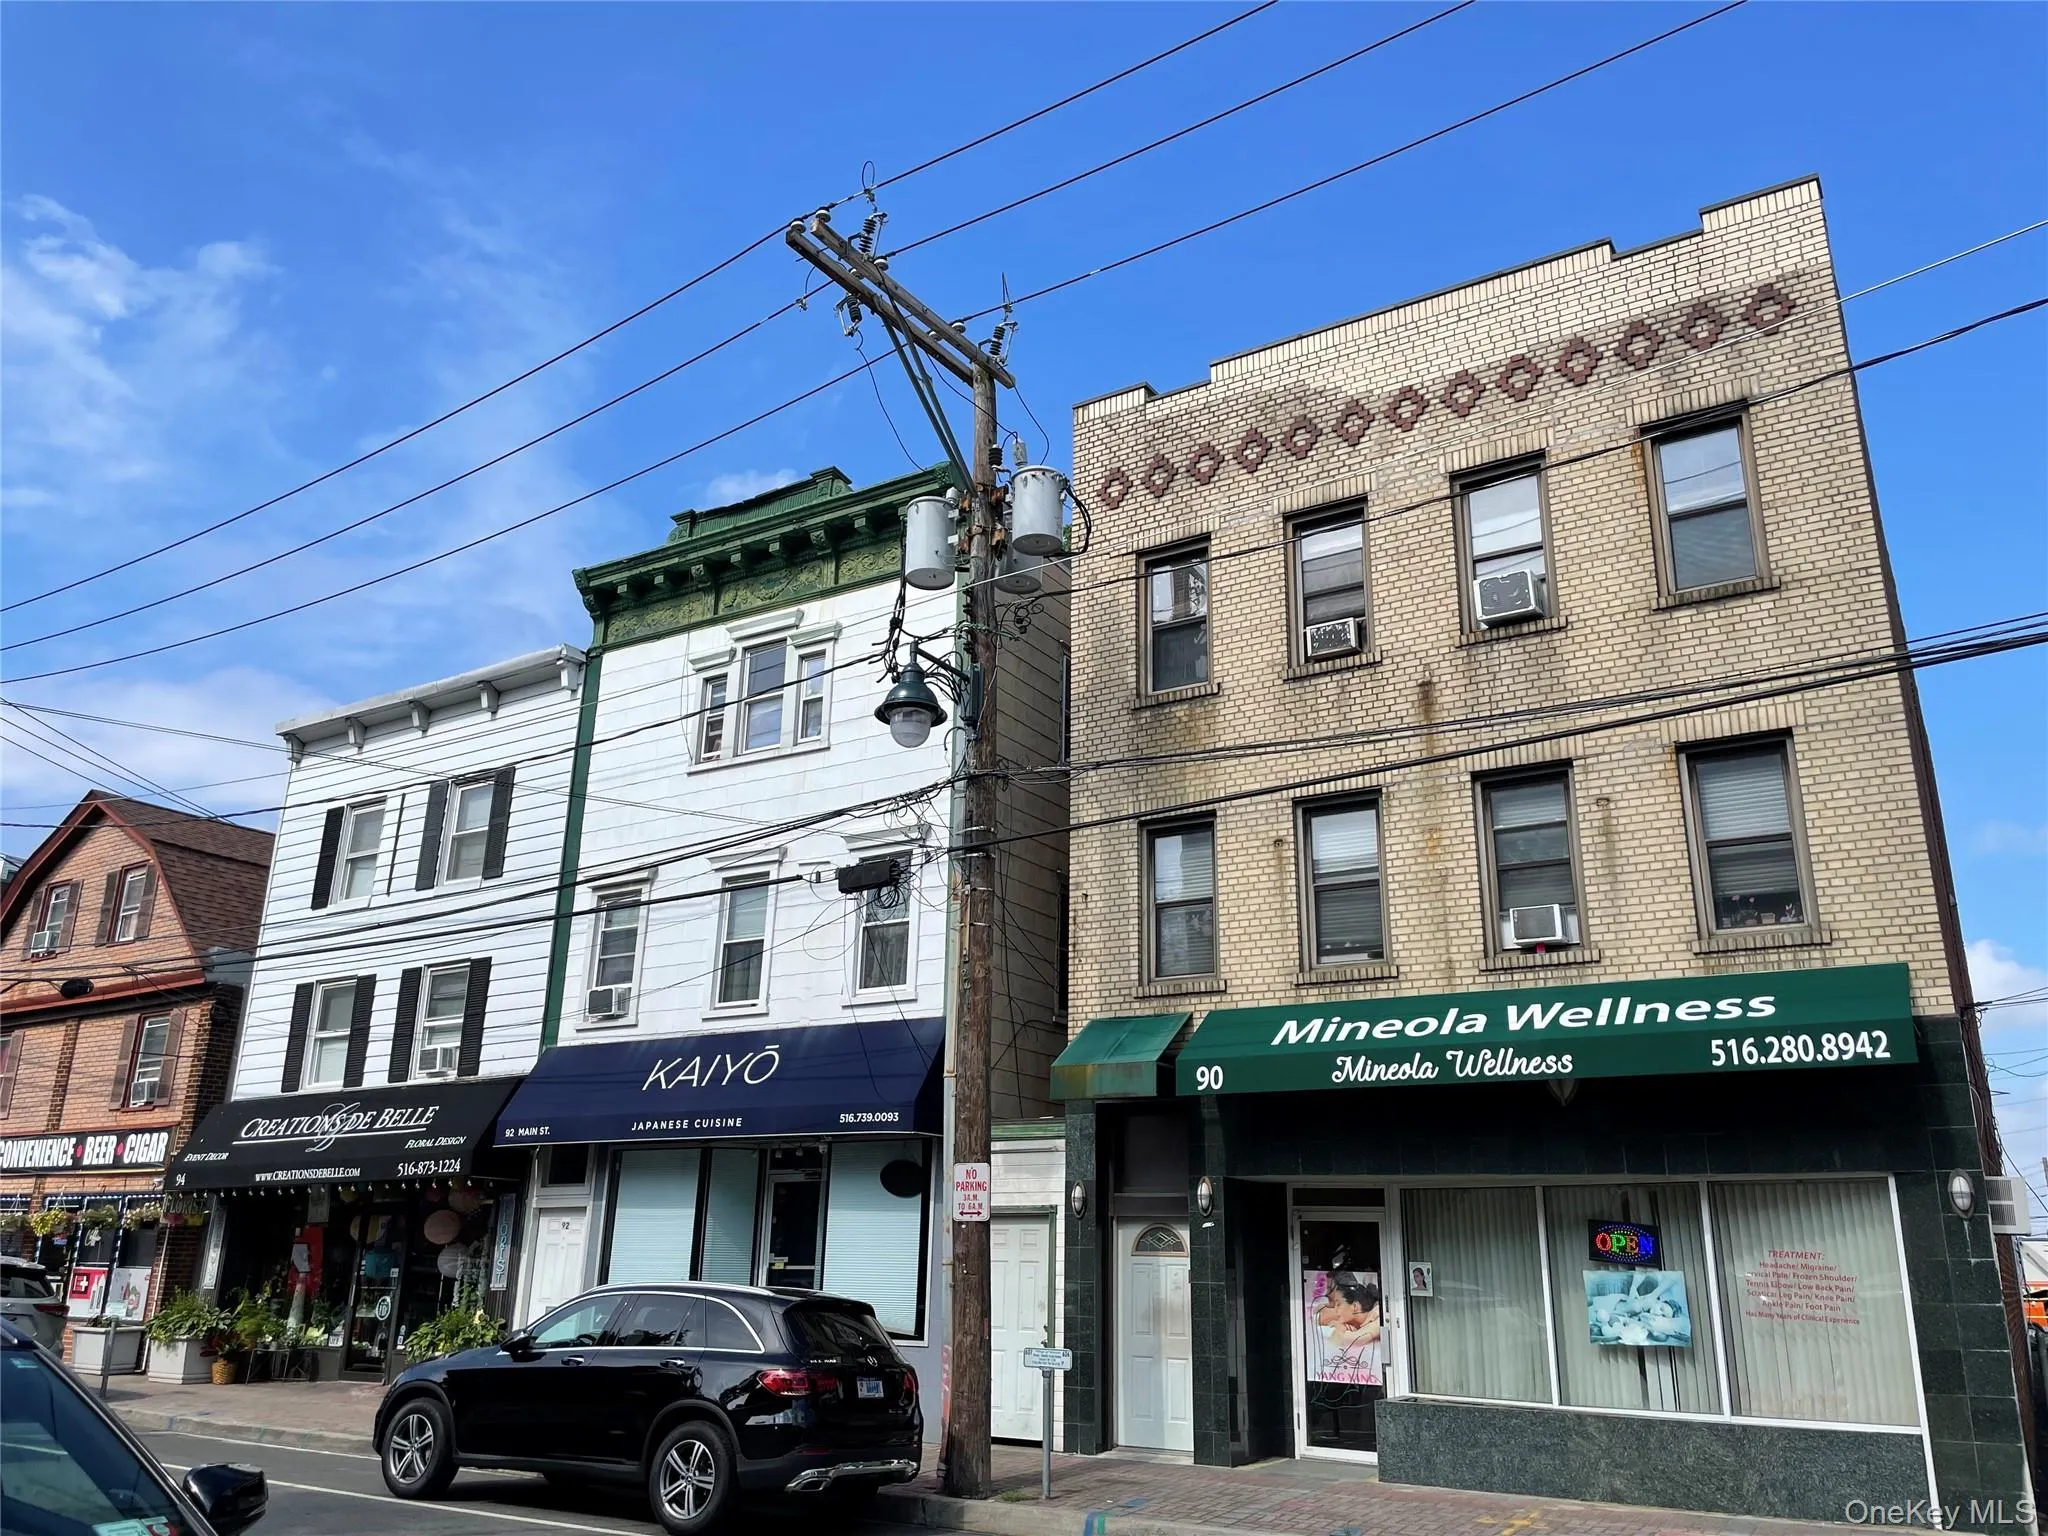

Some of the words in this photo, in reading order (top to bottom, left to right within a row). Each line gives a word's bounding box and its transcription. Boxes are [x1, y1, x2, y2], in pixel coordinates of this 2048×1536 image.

[1271, 1008, 1488, 1046] Mineola
[1506, 995, 1776, 1032] Wellness
[1710, 1030, 1891, 1067] 516.280.8942
[641, 1044, 780, 1091] KAIYŌ
[1331, 1053, 1440, 1084] Mineola
[1446, 1047, 1574, 1078] Wellness
[1196, 1065, 1224, 1091] 90
[241, 1112, 346, 1138] CREATIONS
[344, 1111, 377, 1131] DE
[373, 1106, 440, 1129] BELLE
[631, 1120, 689, 1131] JAPANESE
[694, 1117, 743, 1129] CUISINE
[839, 1112, 899, 1124] 516.739.0093
[505, 1128, 515, 1137] 92
[518, 1127, 538, 1137] MAIN
[539, 1126, 551, 1136] ST.
[405, 1139, 434, 1149] FLORAL
[435, 1136, 467, 1147] DESIGN
[82, 1135, 117, 1166] BEER
[123, 1132, 169, 1164] CIGAR
[205, 1152, 229, 1161] DECOR
[397, 1158, 461, 1177] 516-873-1224
[175, 1173, 186, 1187] 94
[965, 1168, 978, 1180] NO
[955, 1181, 988, 1192] PARKING
[562, 1222, 570, 1230] 92
[1595, 1232, 1654, 1255] OPEN
[1767, 1249, 1825, 1261] TREATMENT:
[1759, 1261, 1799, 1269] Headache/
[1793, 1273, 1818, 1281] Frozen
[1798, 1282, 1814, 1290] Low
[1815, 1283, 1834, 1292] Back
[1835, 1285, 1855, 1293] Pain/
[1779, 1291, 1792, 1300] Leg
[1814, 1293, 1834, 1301] Knee
[1762, 1300, 1783, 1308] Ankle
[1805, 1302, 1823, 1310] Foot
[1824, 1304, 1841, 1312] Pain
[1758, 1311, 1775, 1320] Many
